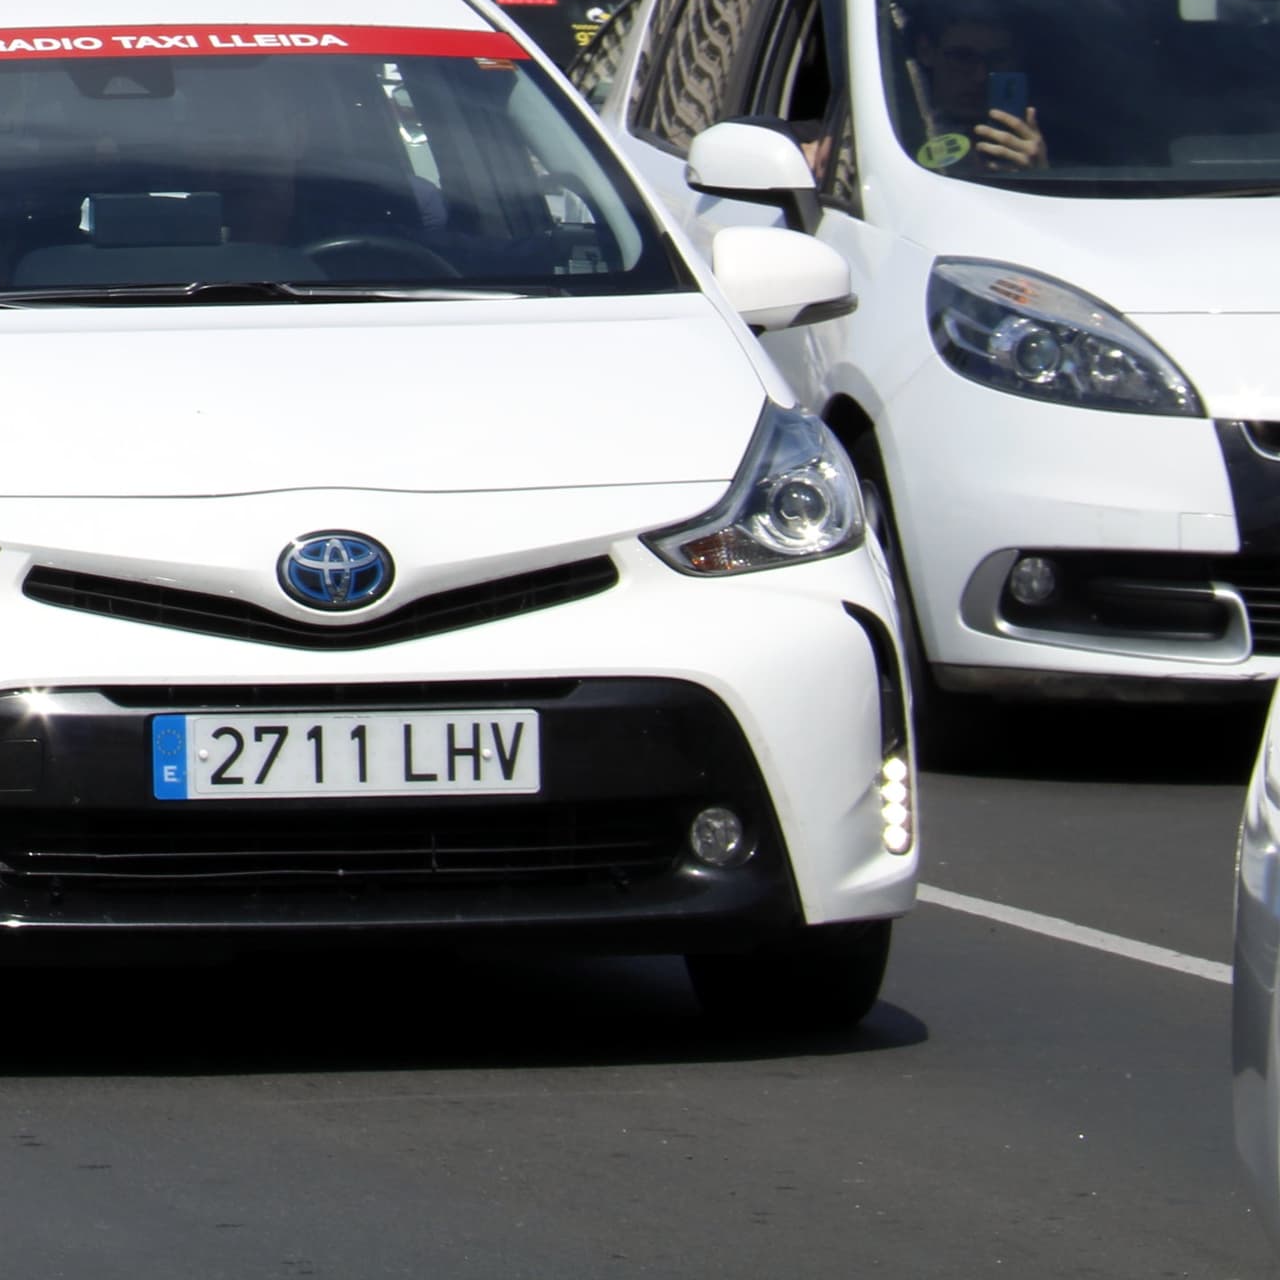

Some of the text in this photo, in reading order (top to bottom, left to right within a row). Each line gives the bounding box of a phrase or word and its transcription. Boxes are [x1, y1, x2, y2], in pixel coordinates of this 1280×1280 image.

[111, 35, 199, 51] TAXI
[207, 33, 349, 50] LLEIDA
[211, 721, 525, 786] 2711 LHV
[162, 765, 179, 783] E
